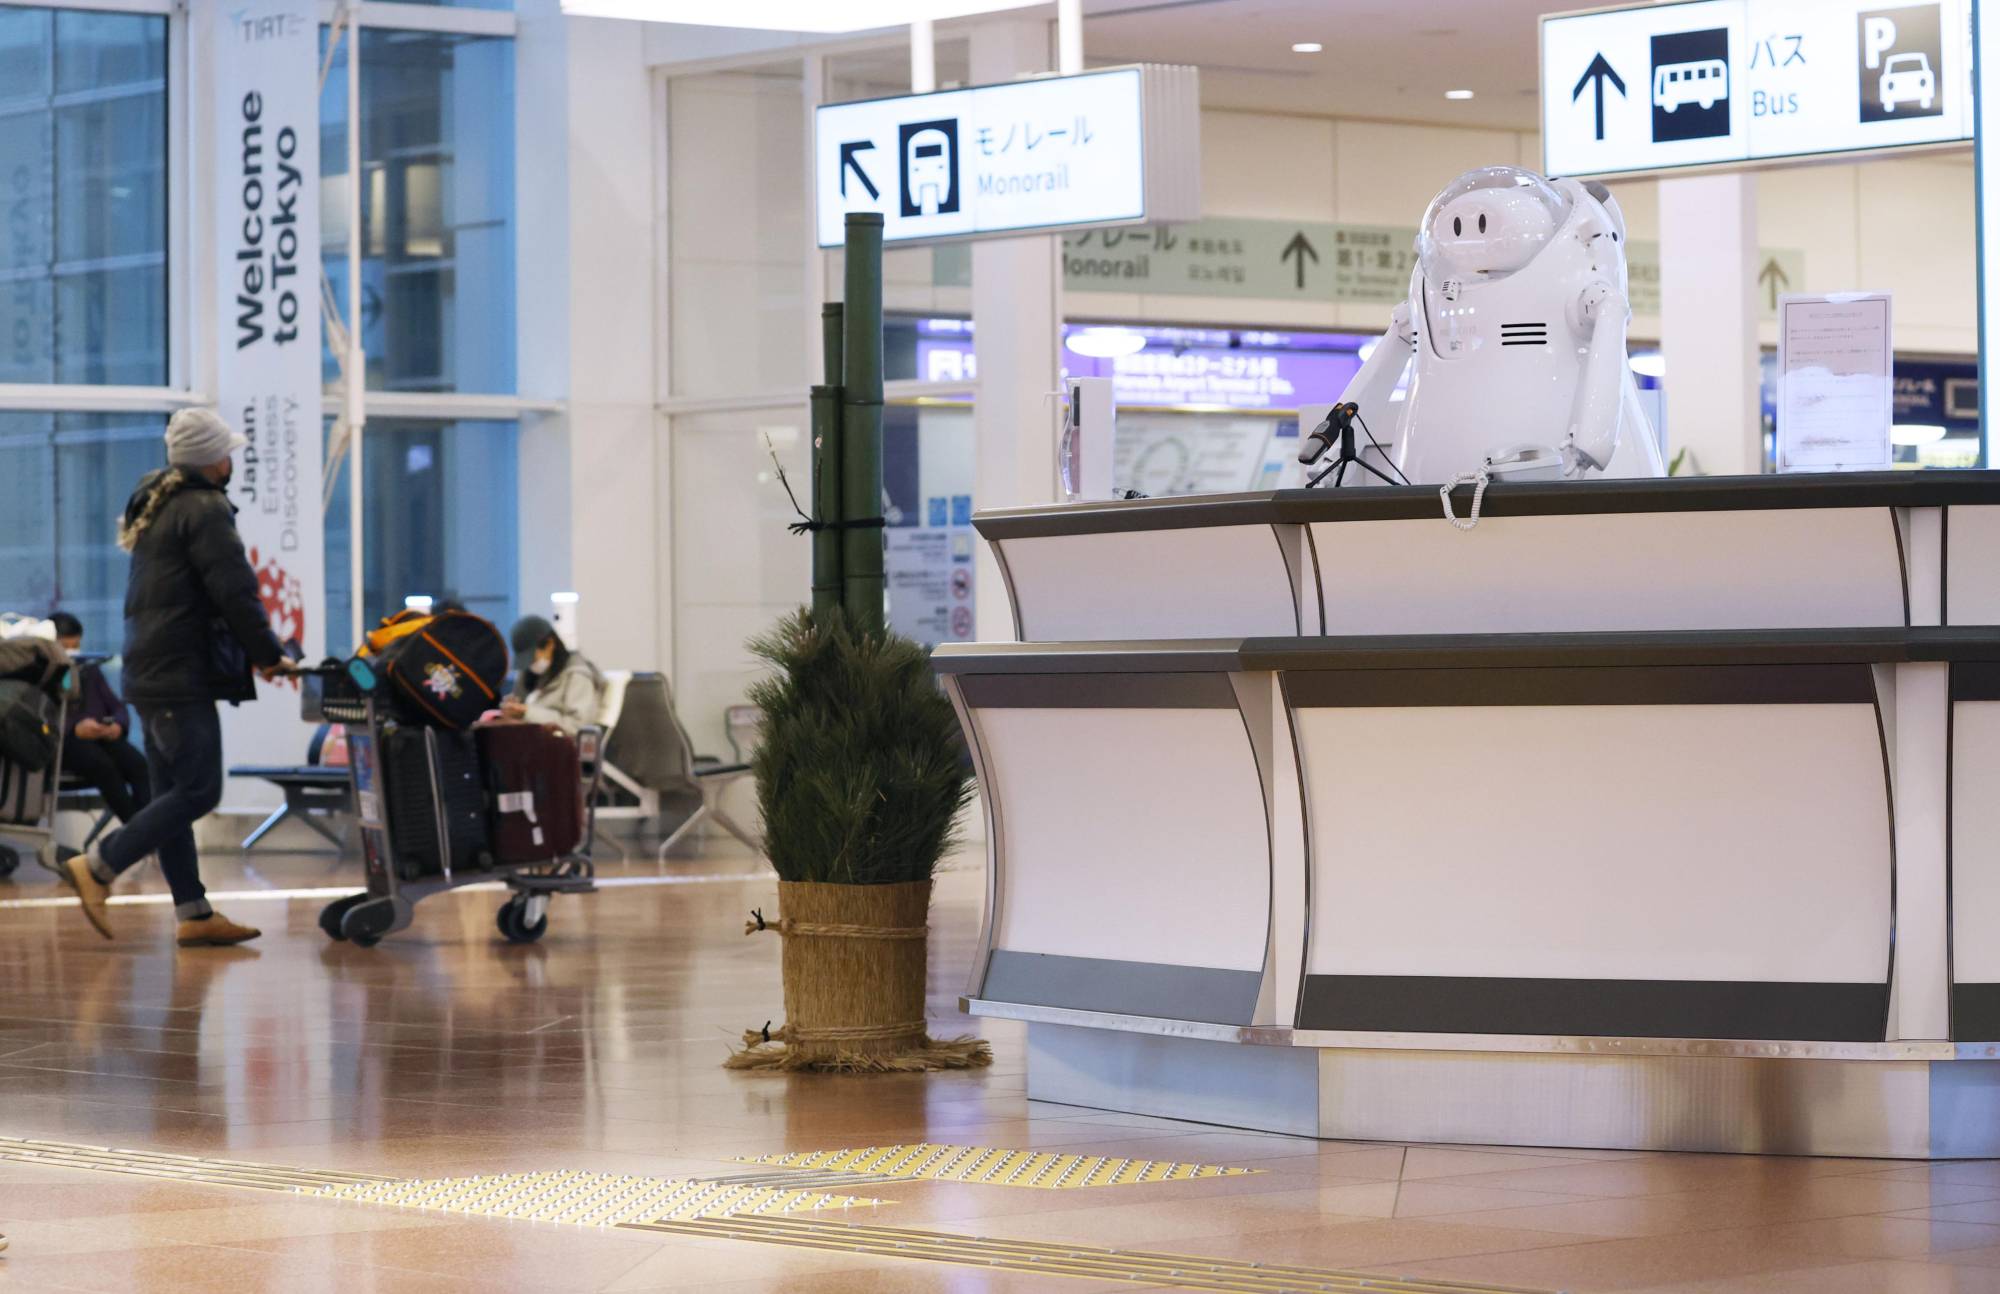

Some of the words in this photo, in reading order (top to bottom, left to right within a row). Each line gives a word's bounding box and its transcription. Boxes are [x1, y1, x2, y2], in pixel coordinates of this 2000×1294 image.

[1751, 34, 1806, 69] バス
[1753, 90, 1799, 118] Bus
[976, 115, 1095, 155] モノレール
[977, 162, 1070, 196] Monorail
[237, 90, 264, 350] Welcome
[271, 125, 302, 291] Tokyo
[1064, 222, 1179, 251] ノレール
[273, 290, 299, 346] to
[239, 397, 259, 503] Japan.
[263, 395, 279, 515] Endless
